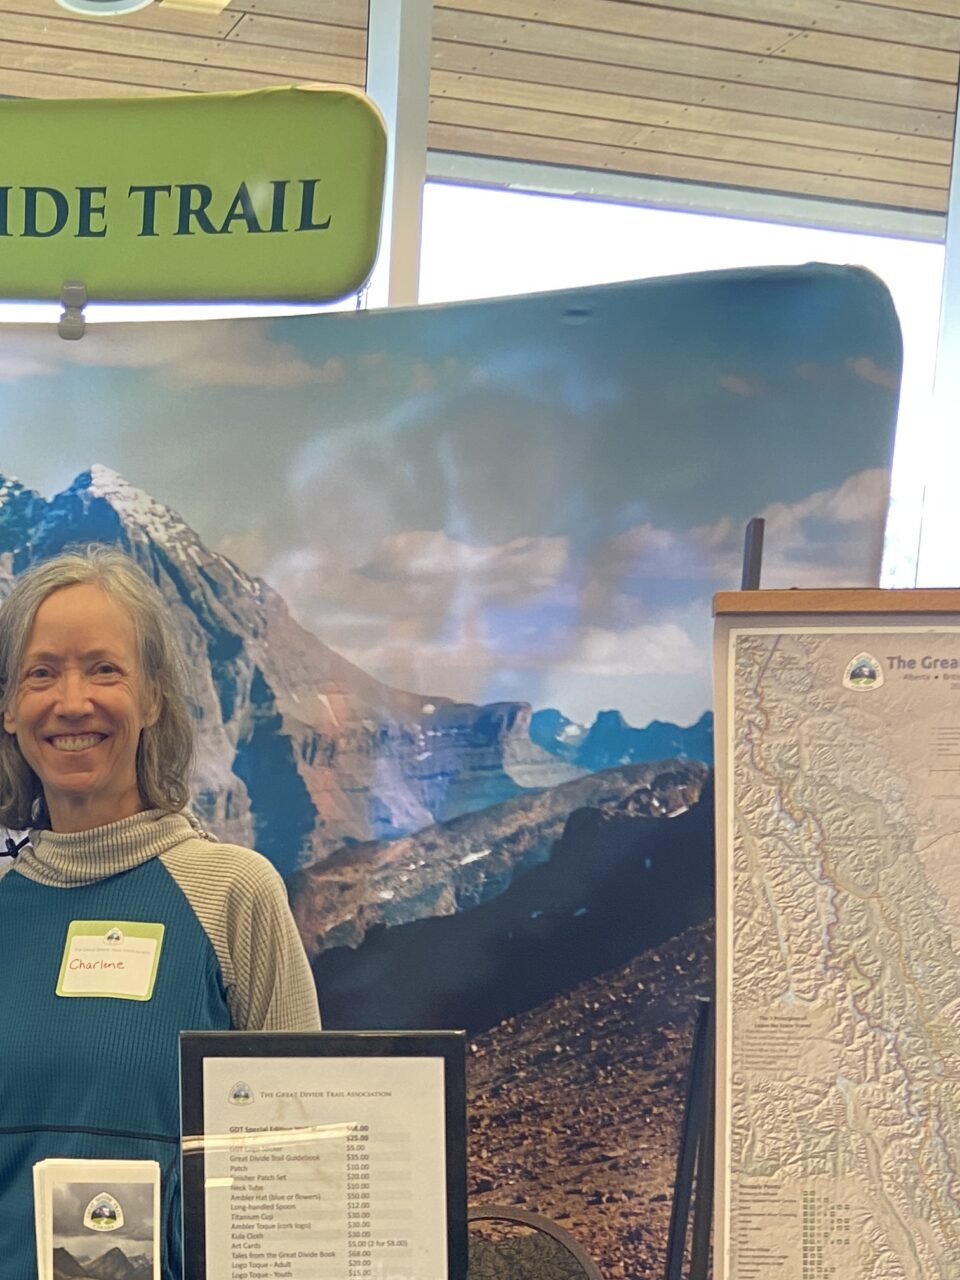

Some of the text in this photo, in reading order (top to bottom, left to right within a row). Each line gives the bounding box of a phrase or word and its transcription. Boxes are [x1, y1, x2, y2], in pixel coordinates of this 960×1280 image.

[128, 178, 332, 238] TRAIL
[886, 655, 959, 669] The Grea
